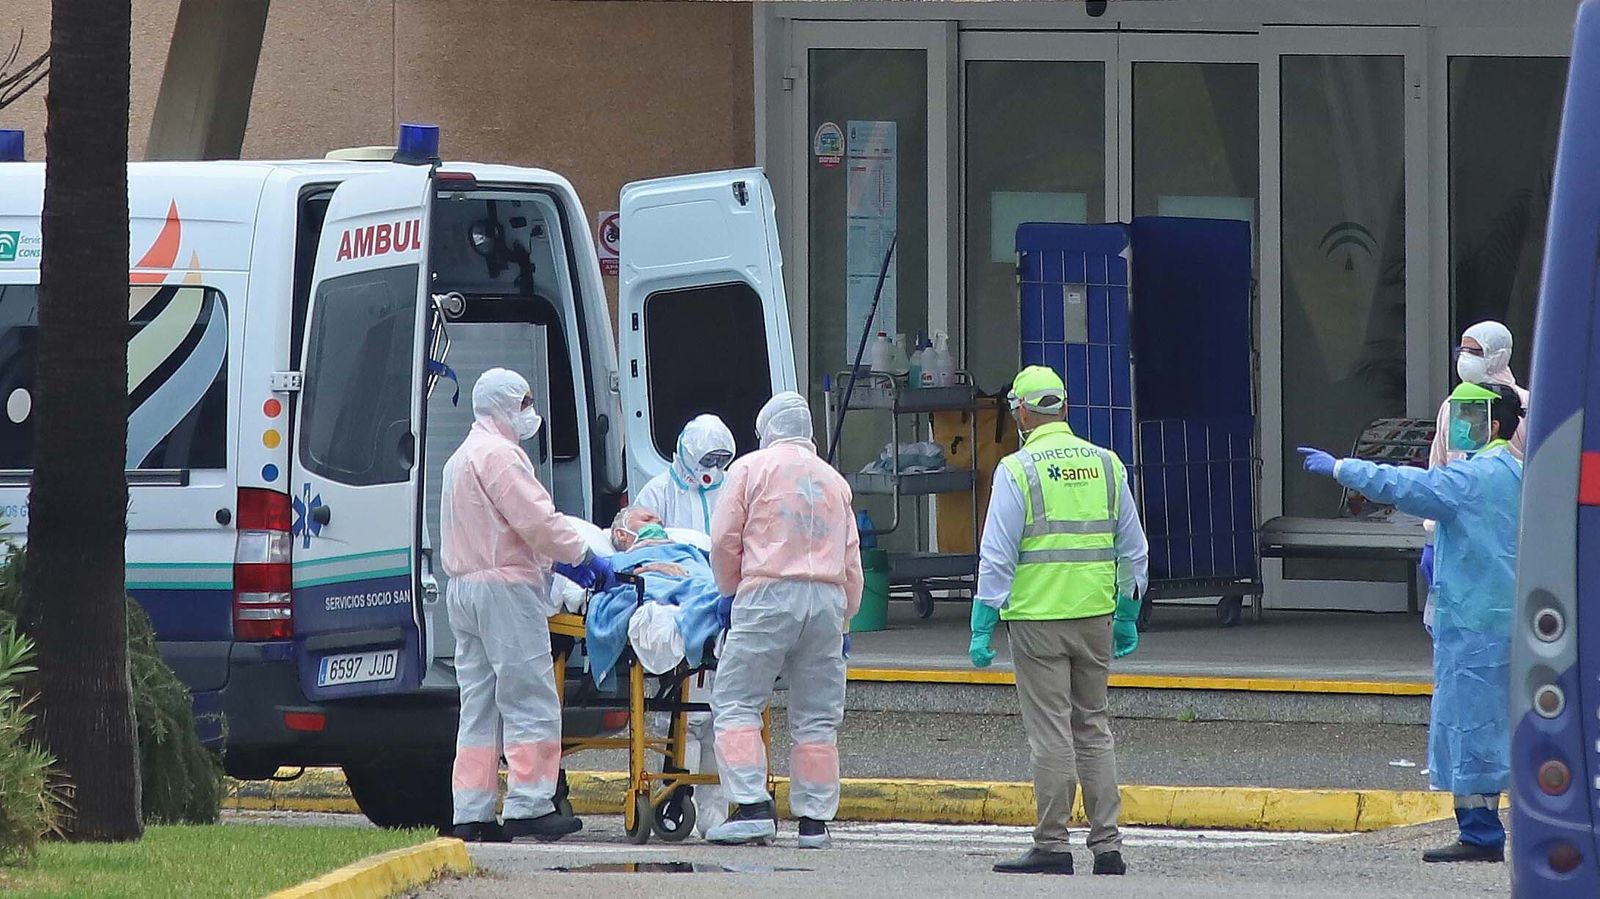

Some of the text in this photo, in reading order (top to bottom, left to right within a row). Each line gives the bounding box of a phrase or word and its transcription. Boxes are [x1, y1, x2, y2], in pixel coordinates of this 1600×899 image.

[336, 219, 420, 262] AMBUL
[1031, 447, 1102, 463] DIRECTOR
[1061, 467, 1099, 481] samu
[325, 589, 411, 611] SERVICIOS SOCIO SAN
[329, 654, 394, 681] 6597 JJD
